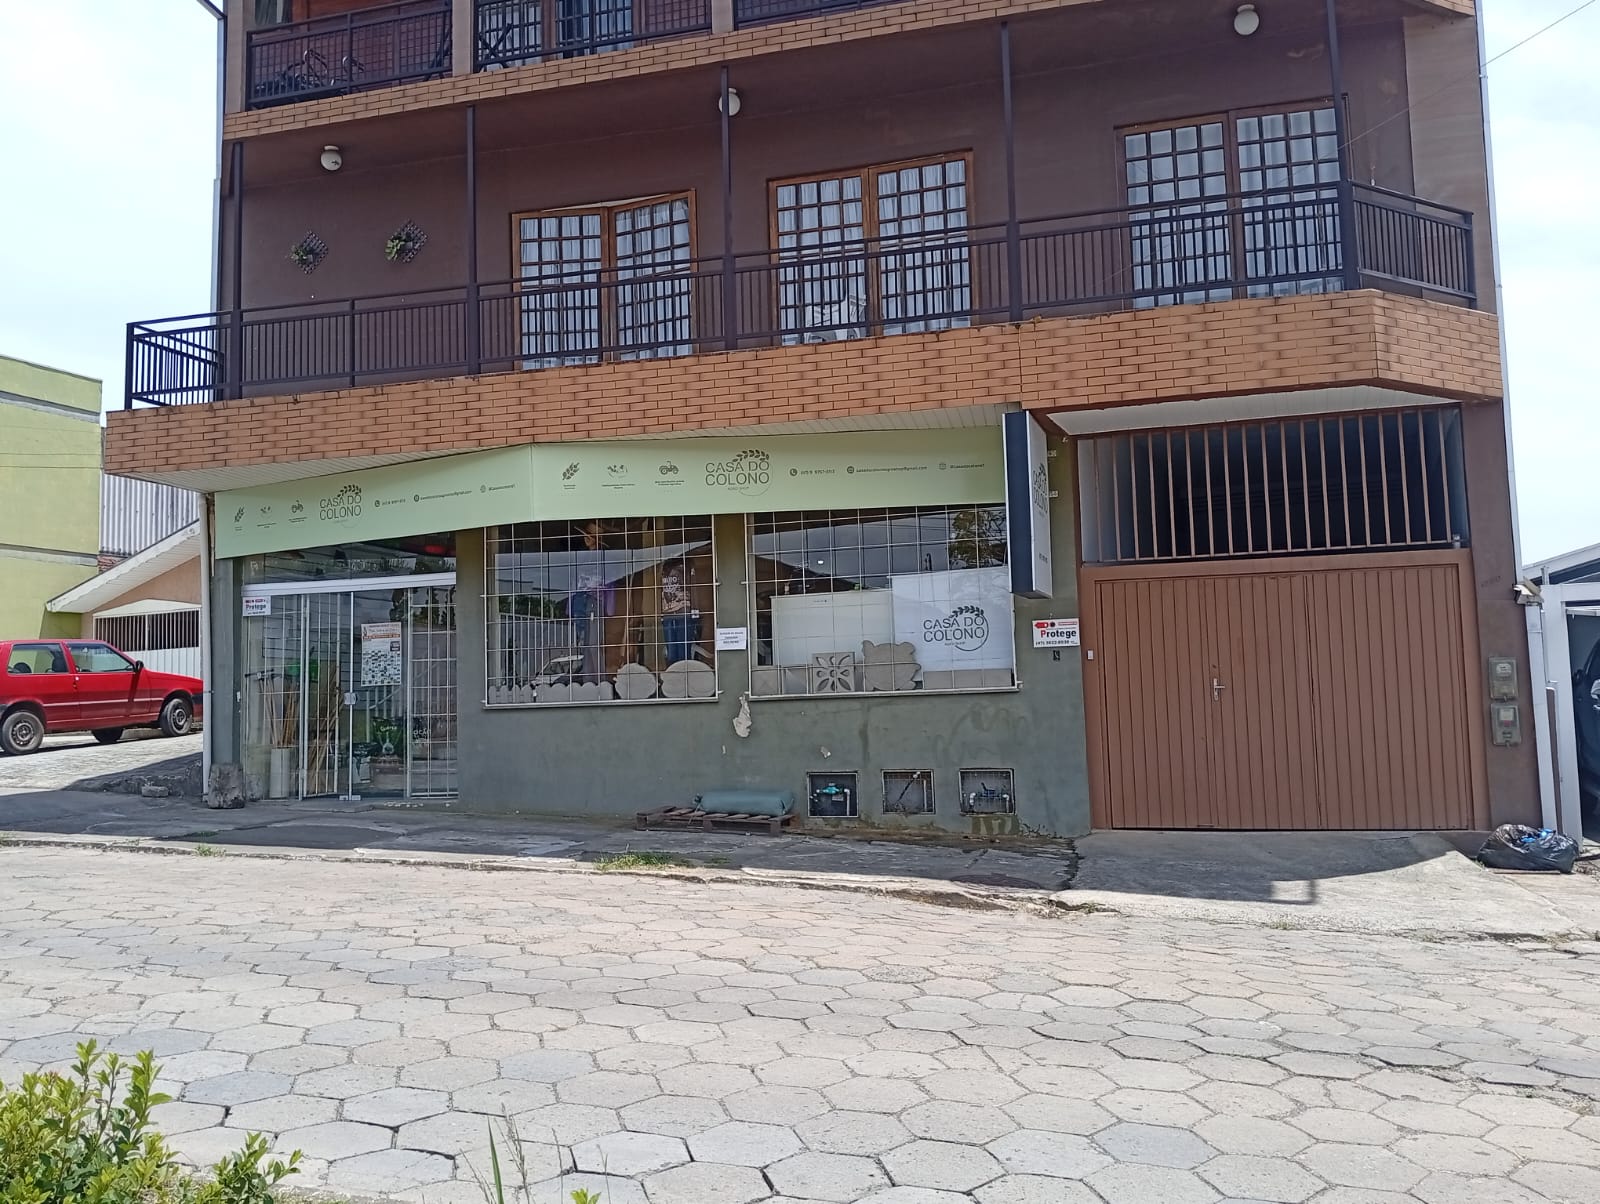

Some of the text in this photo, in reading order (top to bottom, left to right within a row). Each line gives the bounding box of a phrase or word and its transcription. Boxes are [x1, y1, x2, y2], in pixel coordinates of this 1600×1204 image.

[705, 460, 770, 473] CASA DO
[705, 472, 770, 486] COLONO
[320, 494, 362, 509] CASA DO
[320, 504, 362, 520] COLONO
[923, 616, 985, 630] CASA DO
[923, 626, 985, 642] COLONO
[1040, 629, 1077, 639] Protege
